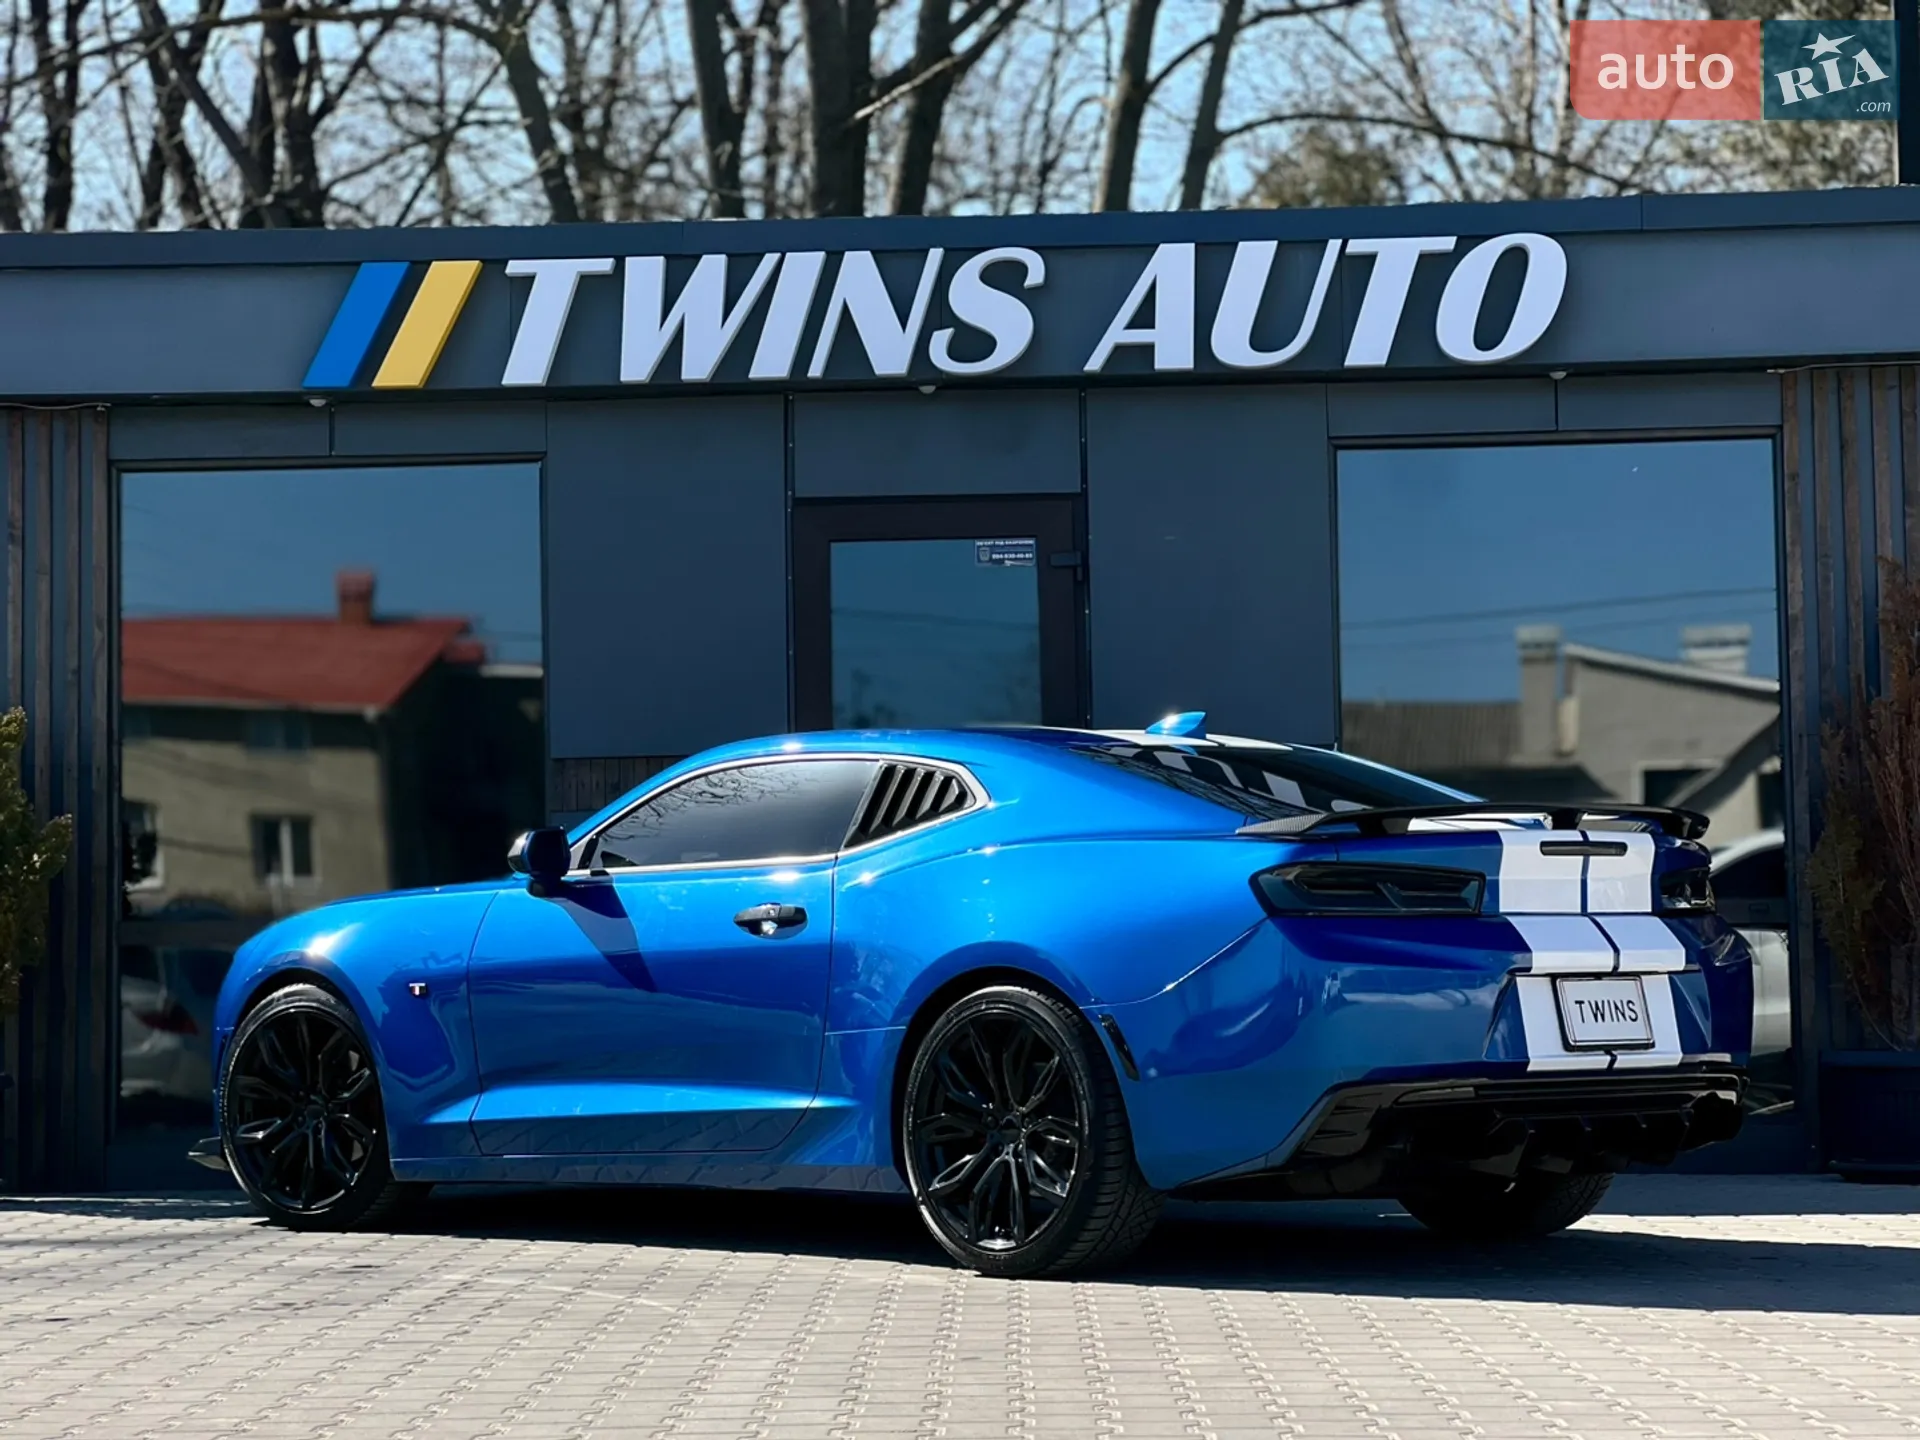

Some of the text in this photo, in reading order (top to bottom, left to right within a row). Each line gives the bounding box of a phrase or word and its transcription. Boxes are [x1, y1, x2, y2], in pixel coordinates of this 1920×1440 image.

[501, 232, 1568, 388] TWINS AUTO
[1574, 999, 1639, 1024] TWINS
